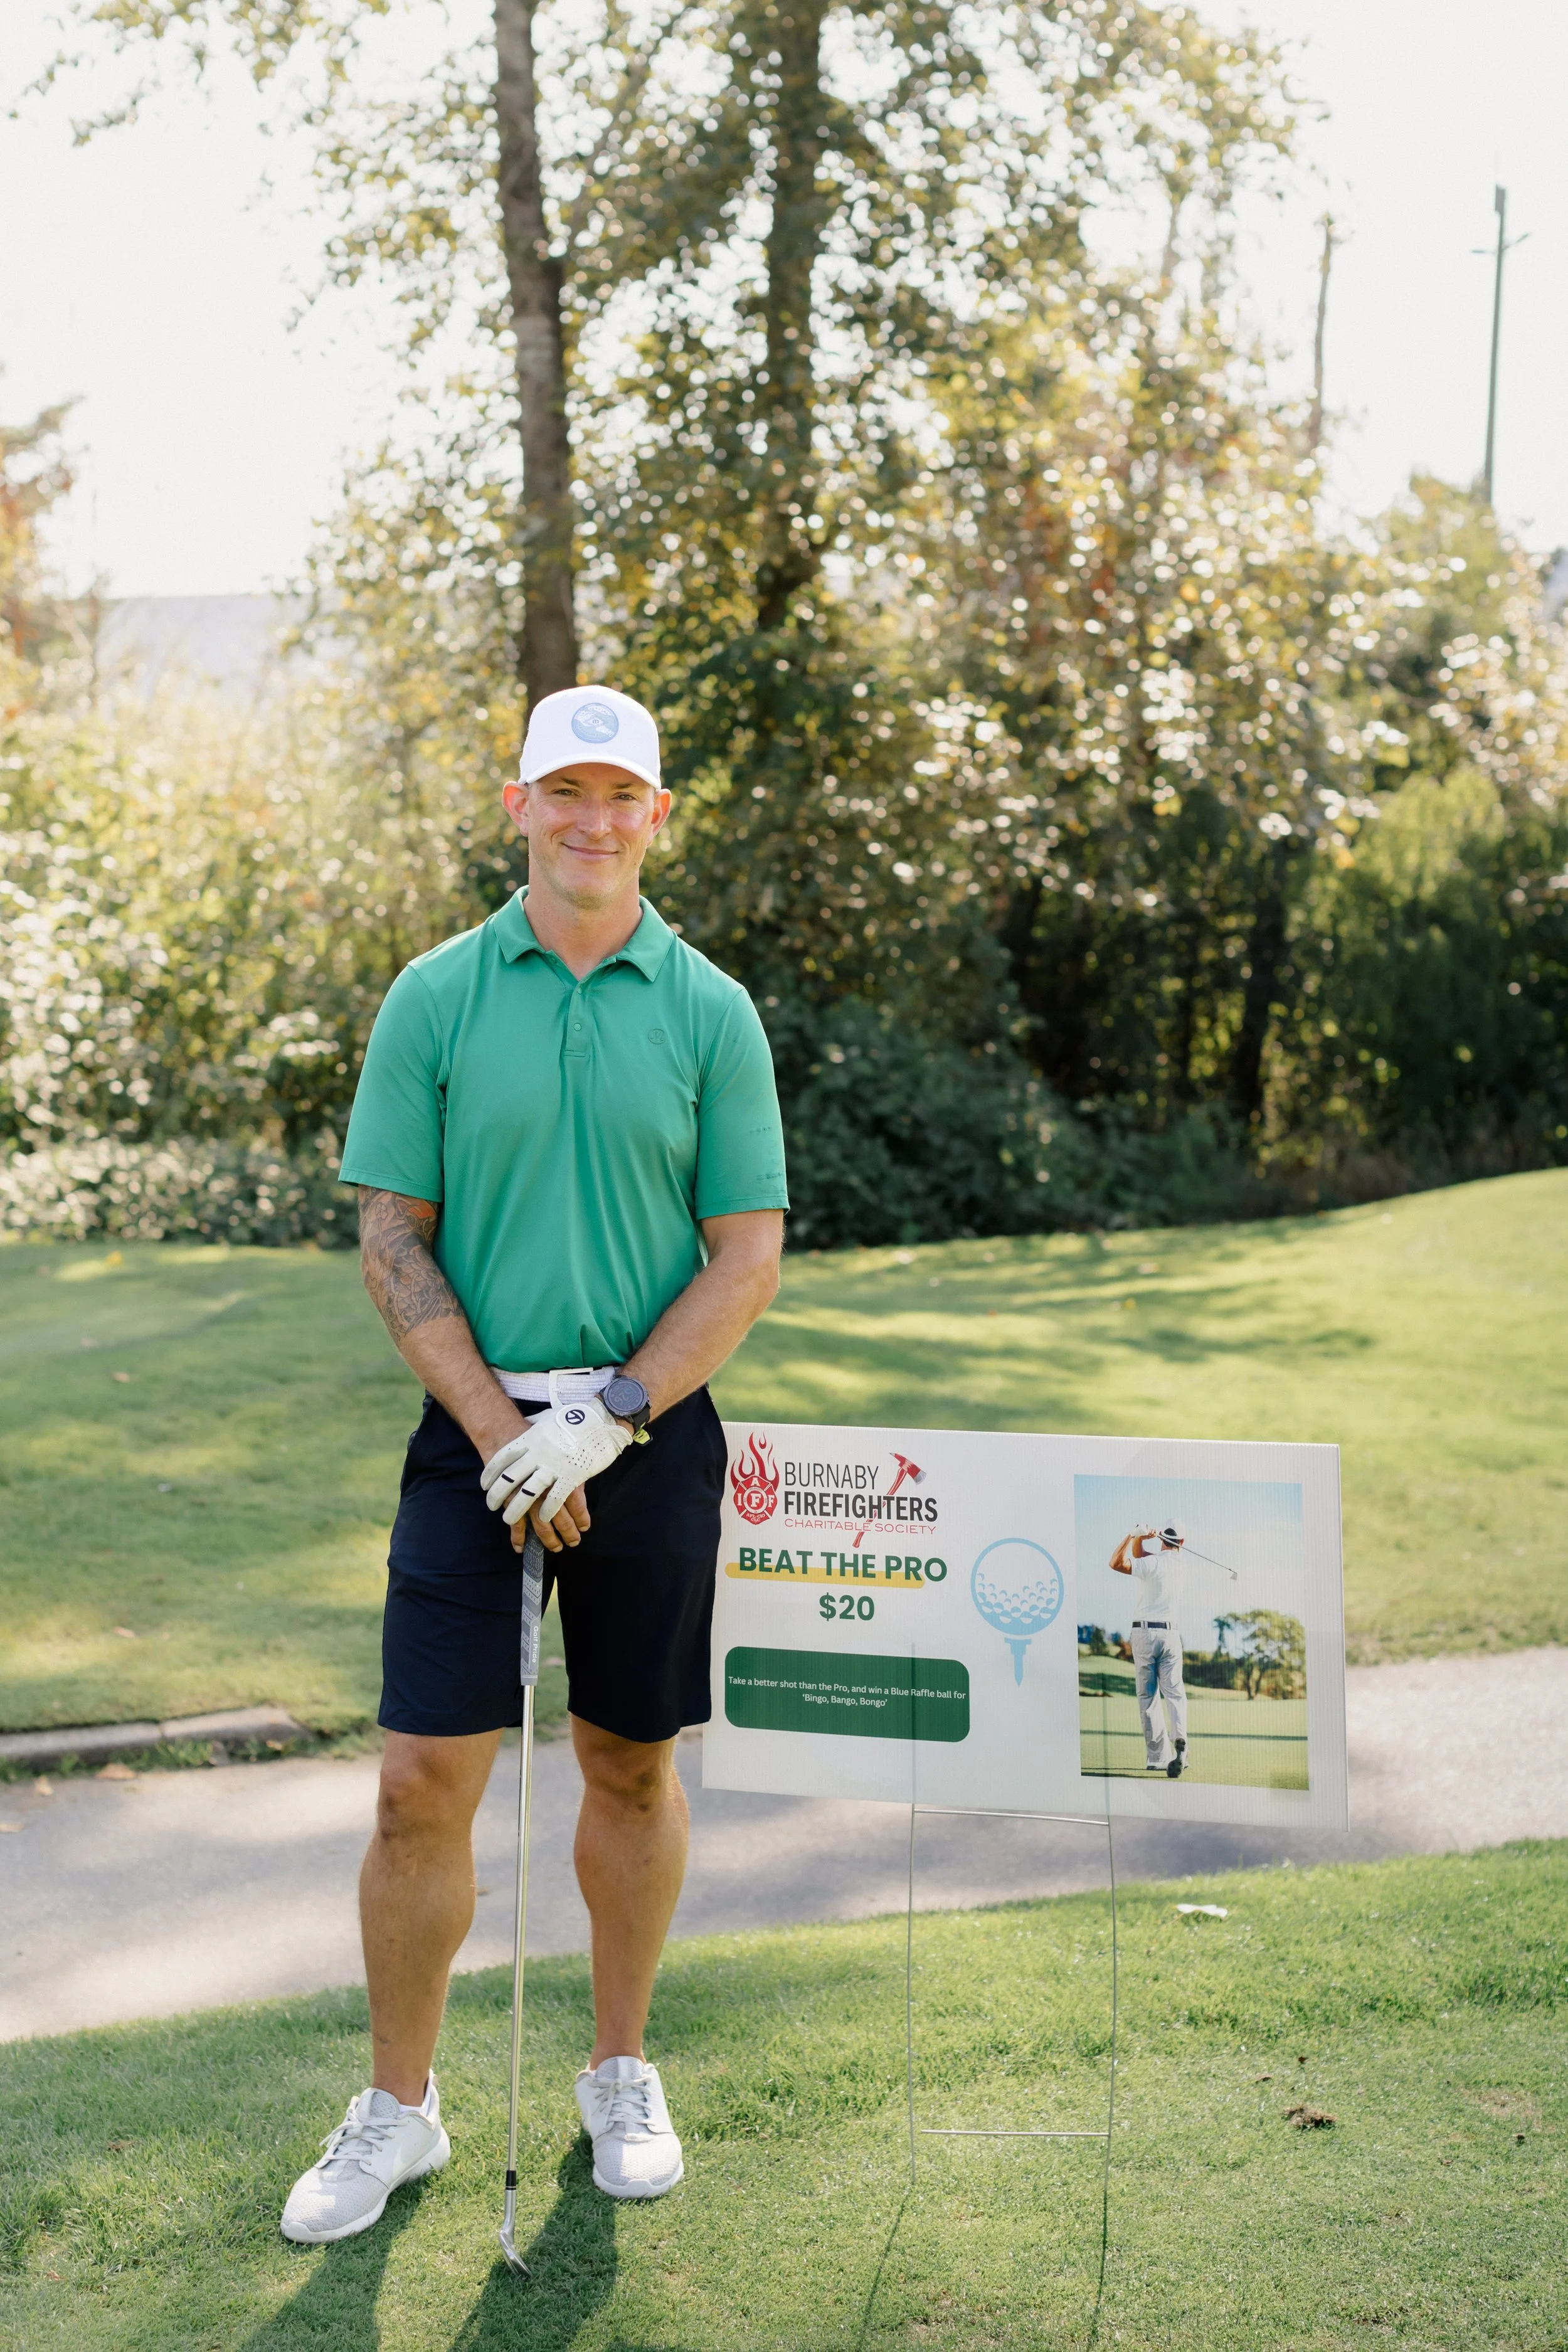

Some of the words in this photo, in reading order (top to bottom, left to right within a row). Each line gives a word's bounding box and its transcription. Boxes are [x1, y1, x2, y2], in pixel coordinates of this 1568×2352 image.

[785, 1461, 879, 1490] BURNABY
[784, 1491, 938, 1522] FIREFIGHTERS
[784, 1518, 871, 1532] CHARITABLE
[874, 1523, 936, 1535] SOCIETY
[739, 1547, 813, 1574] BEAT
[820, 1552, 876, 1579] THE
[885, 1555, 948, 1582] PRO
[819, 1592, 875, 1621] $20
[728, 1676, 746, 1685] Take
[754, 1678, 778, 1687] better
[780, 1680, 797, 1688] shot
[799, 1681, 817, 1690] than
[818, 1683, 832, 1691] the
[834, 1683, 850, 1693] Pro,
[851, 1685, 867, 1693] and
[868, 1686, 882, 1695] win
[891, 1687, 909, 1696] Blue
[911, 1688, 935, 1697] Raffle
[936, 1690, 951, 1698] ball
[953, 1690, 966, 1700] for
[831, 1695, 858, 1706] Bango,
